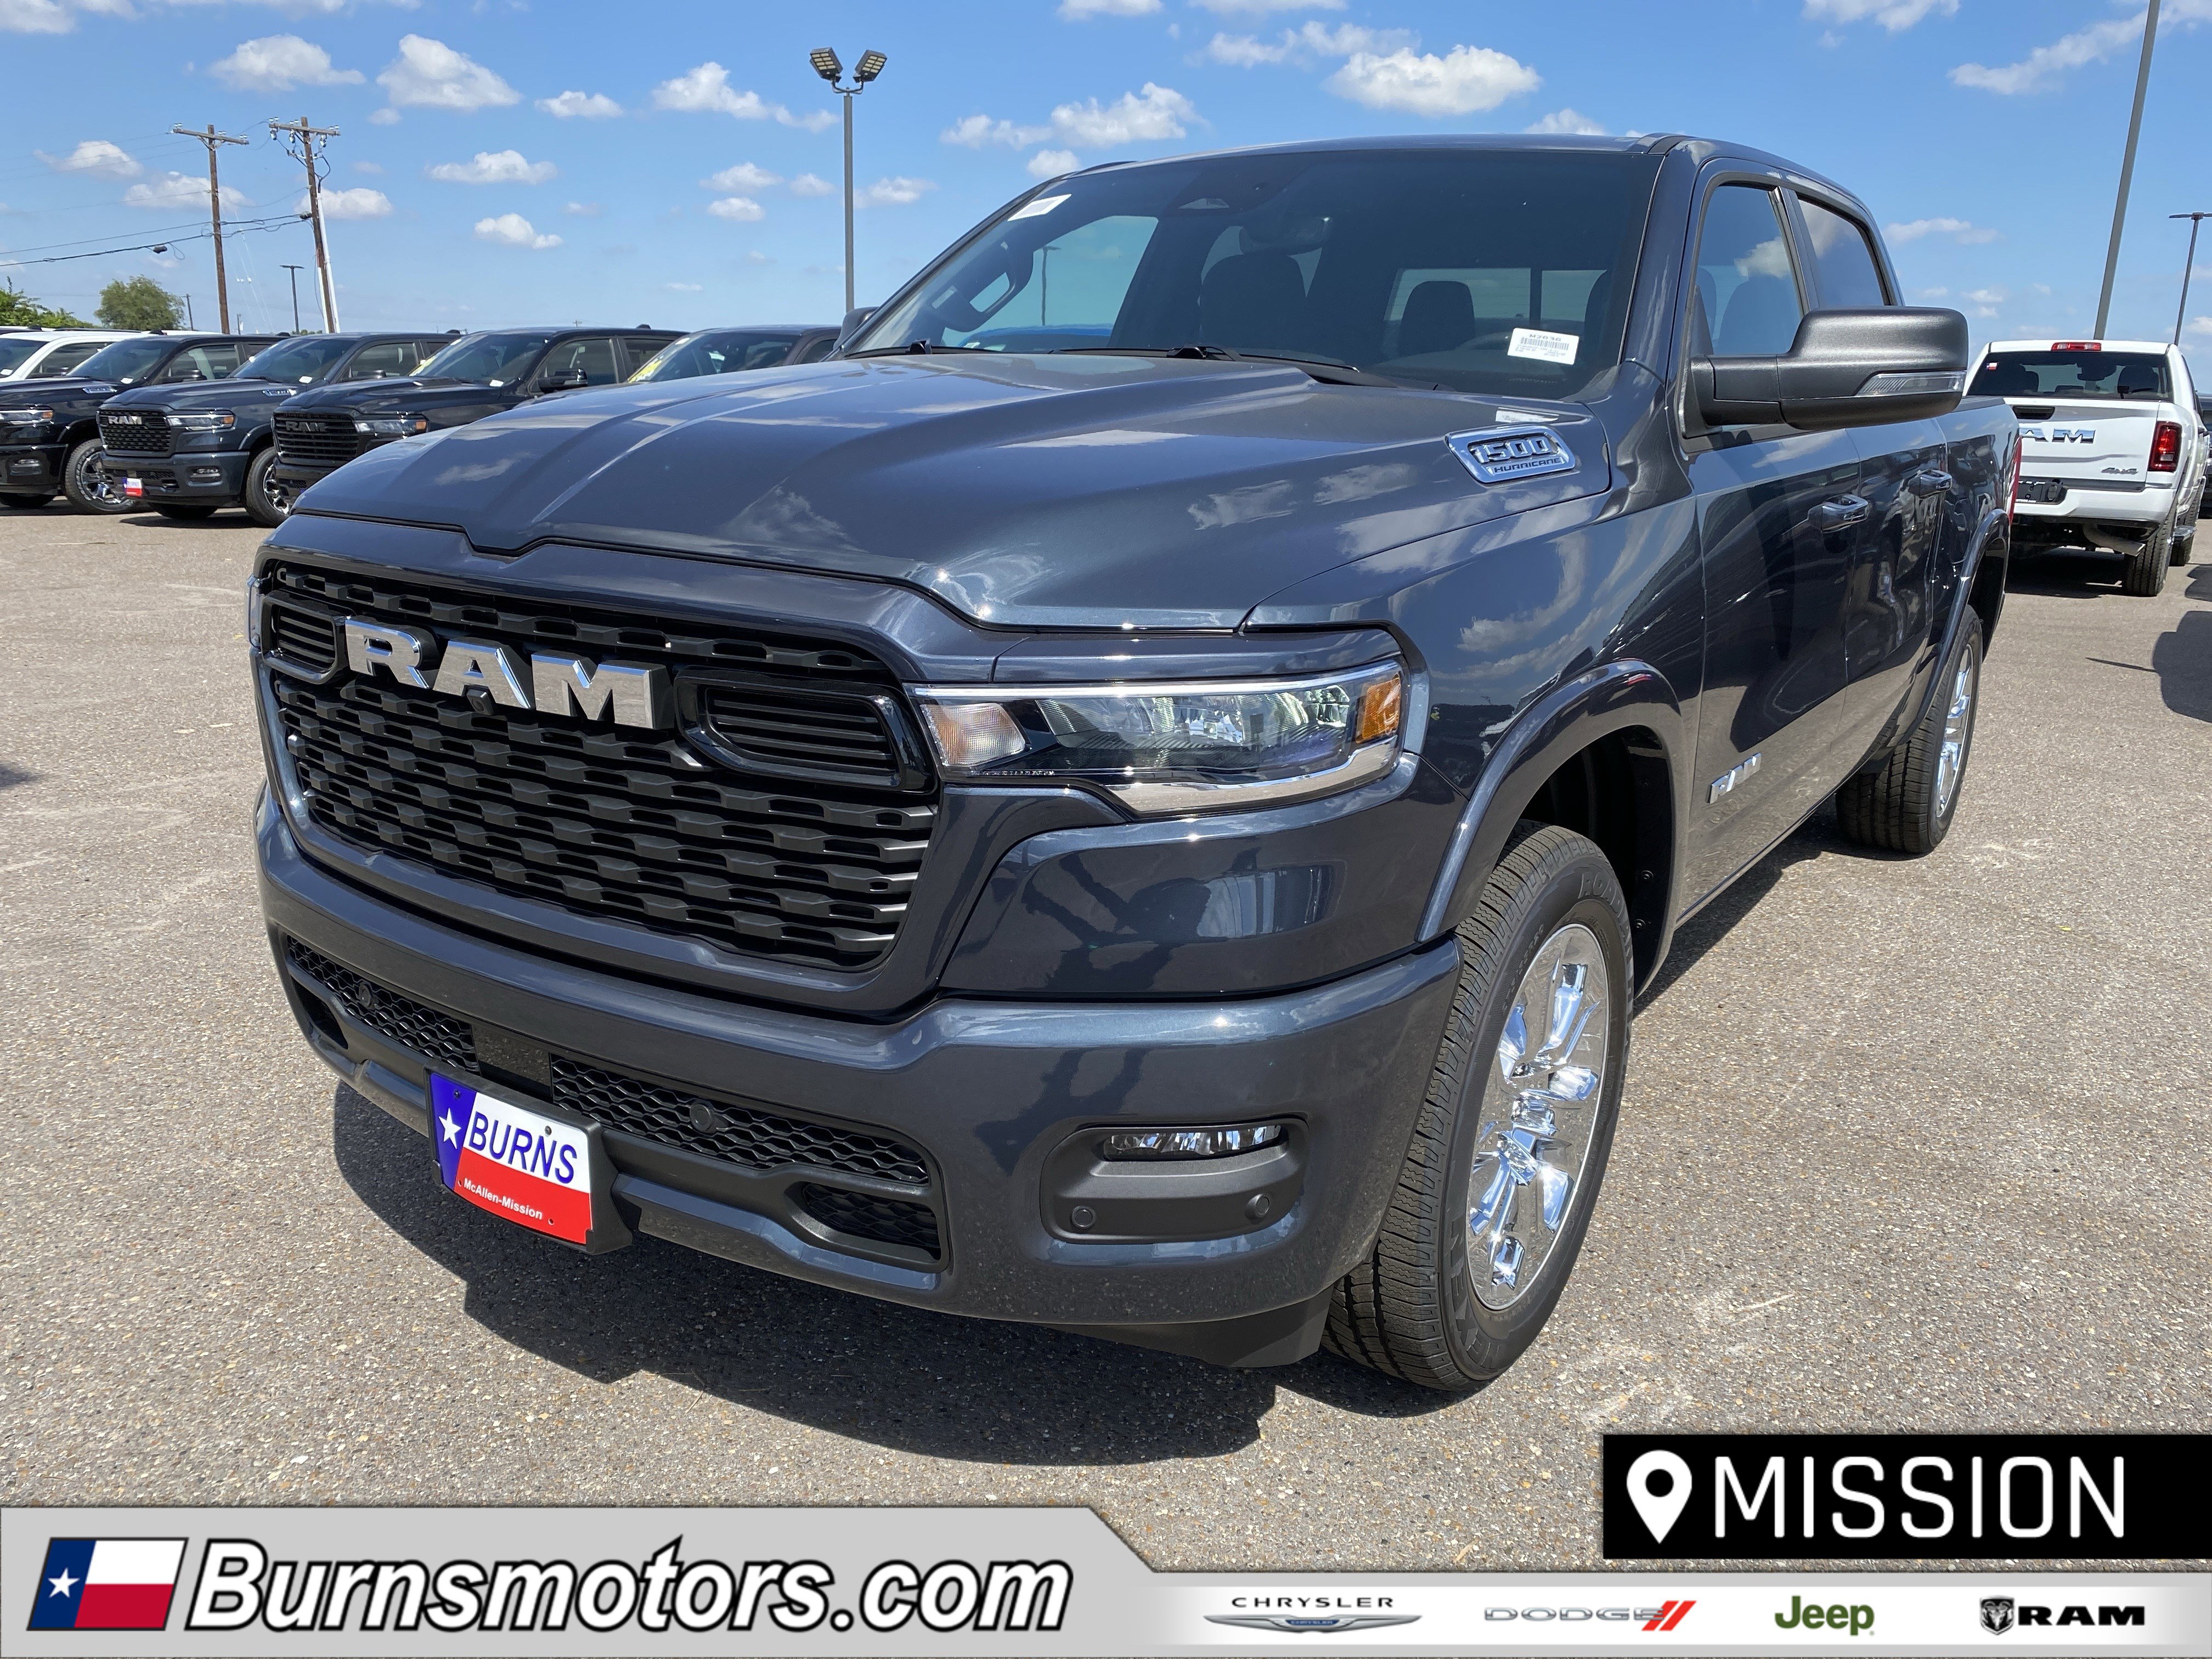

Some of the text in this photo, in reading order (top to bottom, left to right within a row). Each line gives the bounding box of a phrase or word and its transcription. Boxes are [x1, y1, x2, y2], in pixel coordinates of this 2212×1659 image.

[108, 415, 142, 425] RAM
[285, 421, 327, 432] RAM
[2018, 428, 2096, 444] AM
[1470, 438, 1555, 464] 1500
[1494, 458, 1562, 473] HURRICANE
[345, 615, 667, 730] RAM
[469, 1111, 577, 1184] BURNS
[464, 1177, 543, 1220] McAllen-Mission
